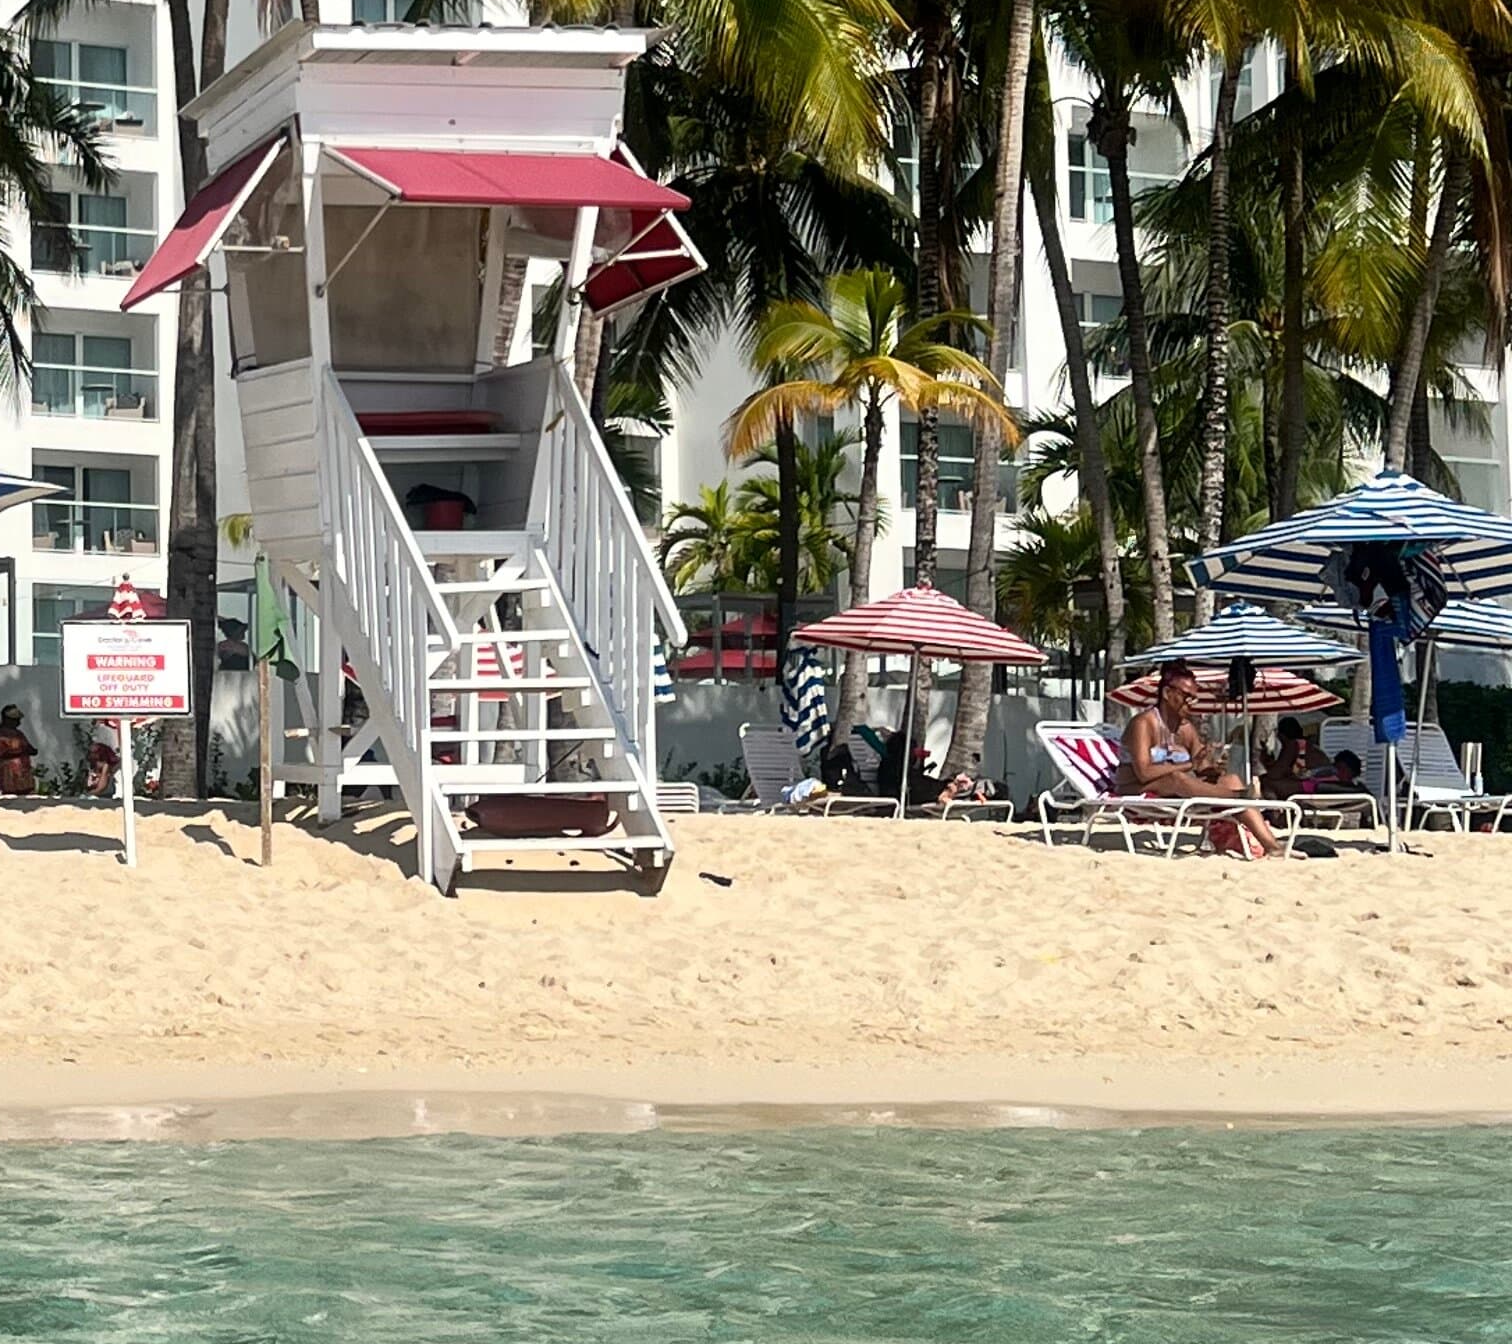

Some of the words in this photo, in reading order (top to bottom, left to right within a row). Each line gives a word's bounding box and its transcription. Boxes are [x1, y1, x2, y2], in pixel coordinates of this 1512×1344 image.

[94, 656, 157, 668] WARNING
[97, 674, 154, 682] LIFEGUARD
[99, 684, 118, 692] OFF
[122, 684, 149, 692] DUTY
[81, 696, 101, 707] NO
[105, 696, 173, 708] SWIMMING
